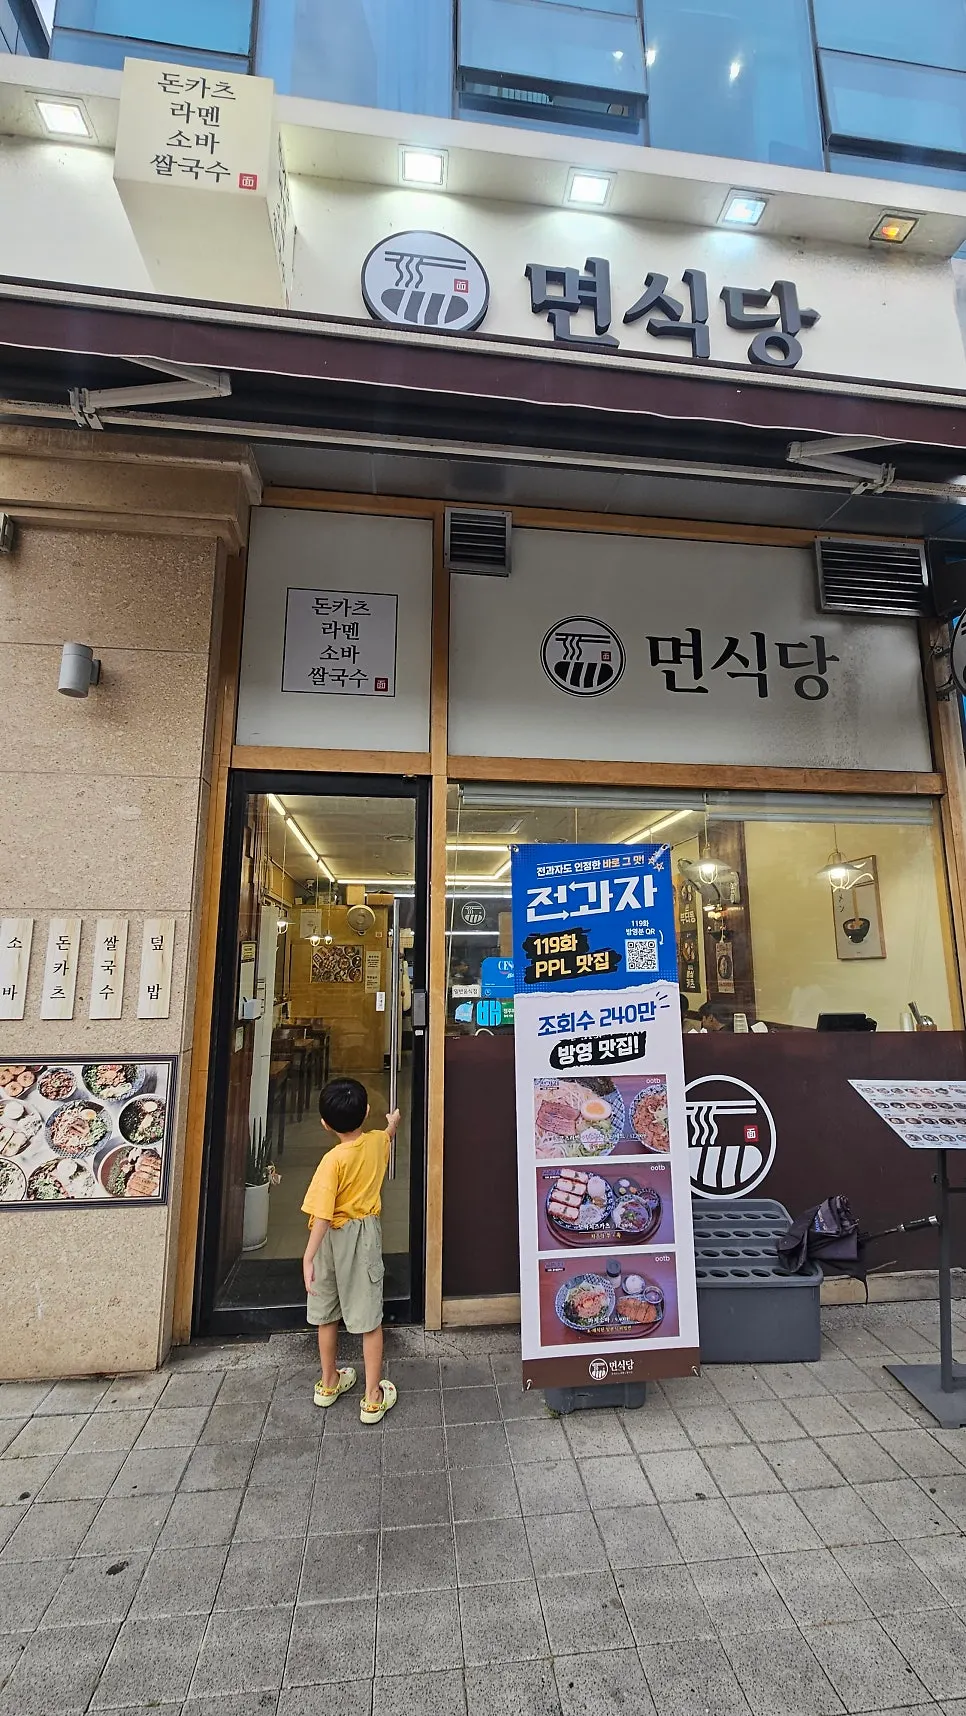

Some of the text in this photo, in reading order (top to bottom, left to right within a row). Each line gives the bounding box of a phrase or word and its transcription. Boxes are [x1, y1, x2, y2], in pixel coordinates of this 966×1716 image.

[158, 72, 236, 100] 돈카츠
[170, 101, 220, 127] 라멘
[166, 130, 220, 154] 소바
[150, 154, 231, 183] 쌀국수
[524, 257, 822, 368] 면식당
[312, 598, 371, 617] 돈카츠
[321, 620, 360, 640] 라멘
[320, 645, 360, 664] 소바
[646, 628, 840, 700] 면식당
[308, 666, 368, 688] 쌀국수
[536, 854, 645, 876] 전과자도 인정한 바로 그 맛!
[526, 874, 658, 922] 전과자
[626, 928, 644, 936] 방영분
[631, 920, 650, 928] 119화
[534, 934, 578, 955] 119화
[2, 937, 23, 1000] 소바
[50, 935, 72, 1000] 돈카츠
[100, 935, 120, 1000] 쌀국수
[147, 935, 164, 1000] 덮밥
[536, 952, 610, 978] PPL 맛집
[538, 1010, 596, 1036] 조회수
[600, 1001, 657, 1026] 240만
[558, 1036, 639, 1066] 방영 맛집!
[746, 1128, 756, 1138] 面
[610, 1358, 634, 1372] 면식당
